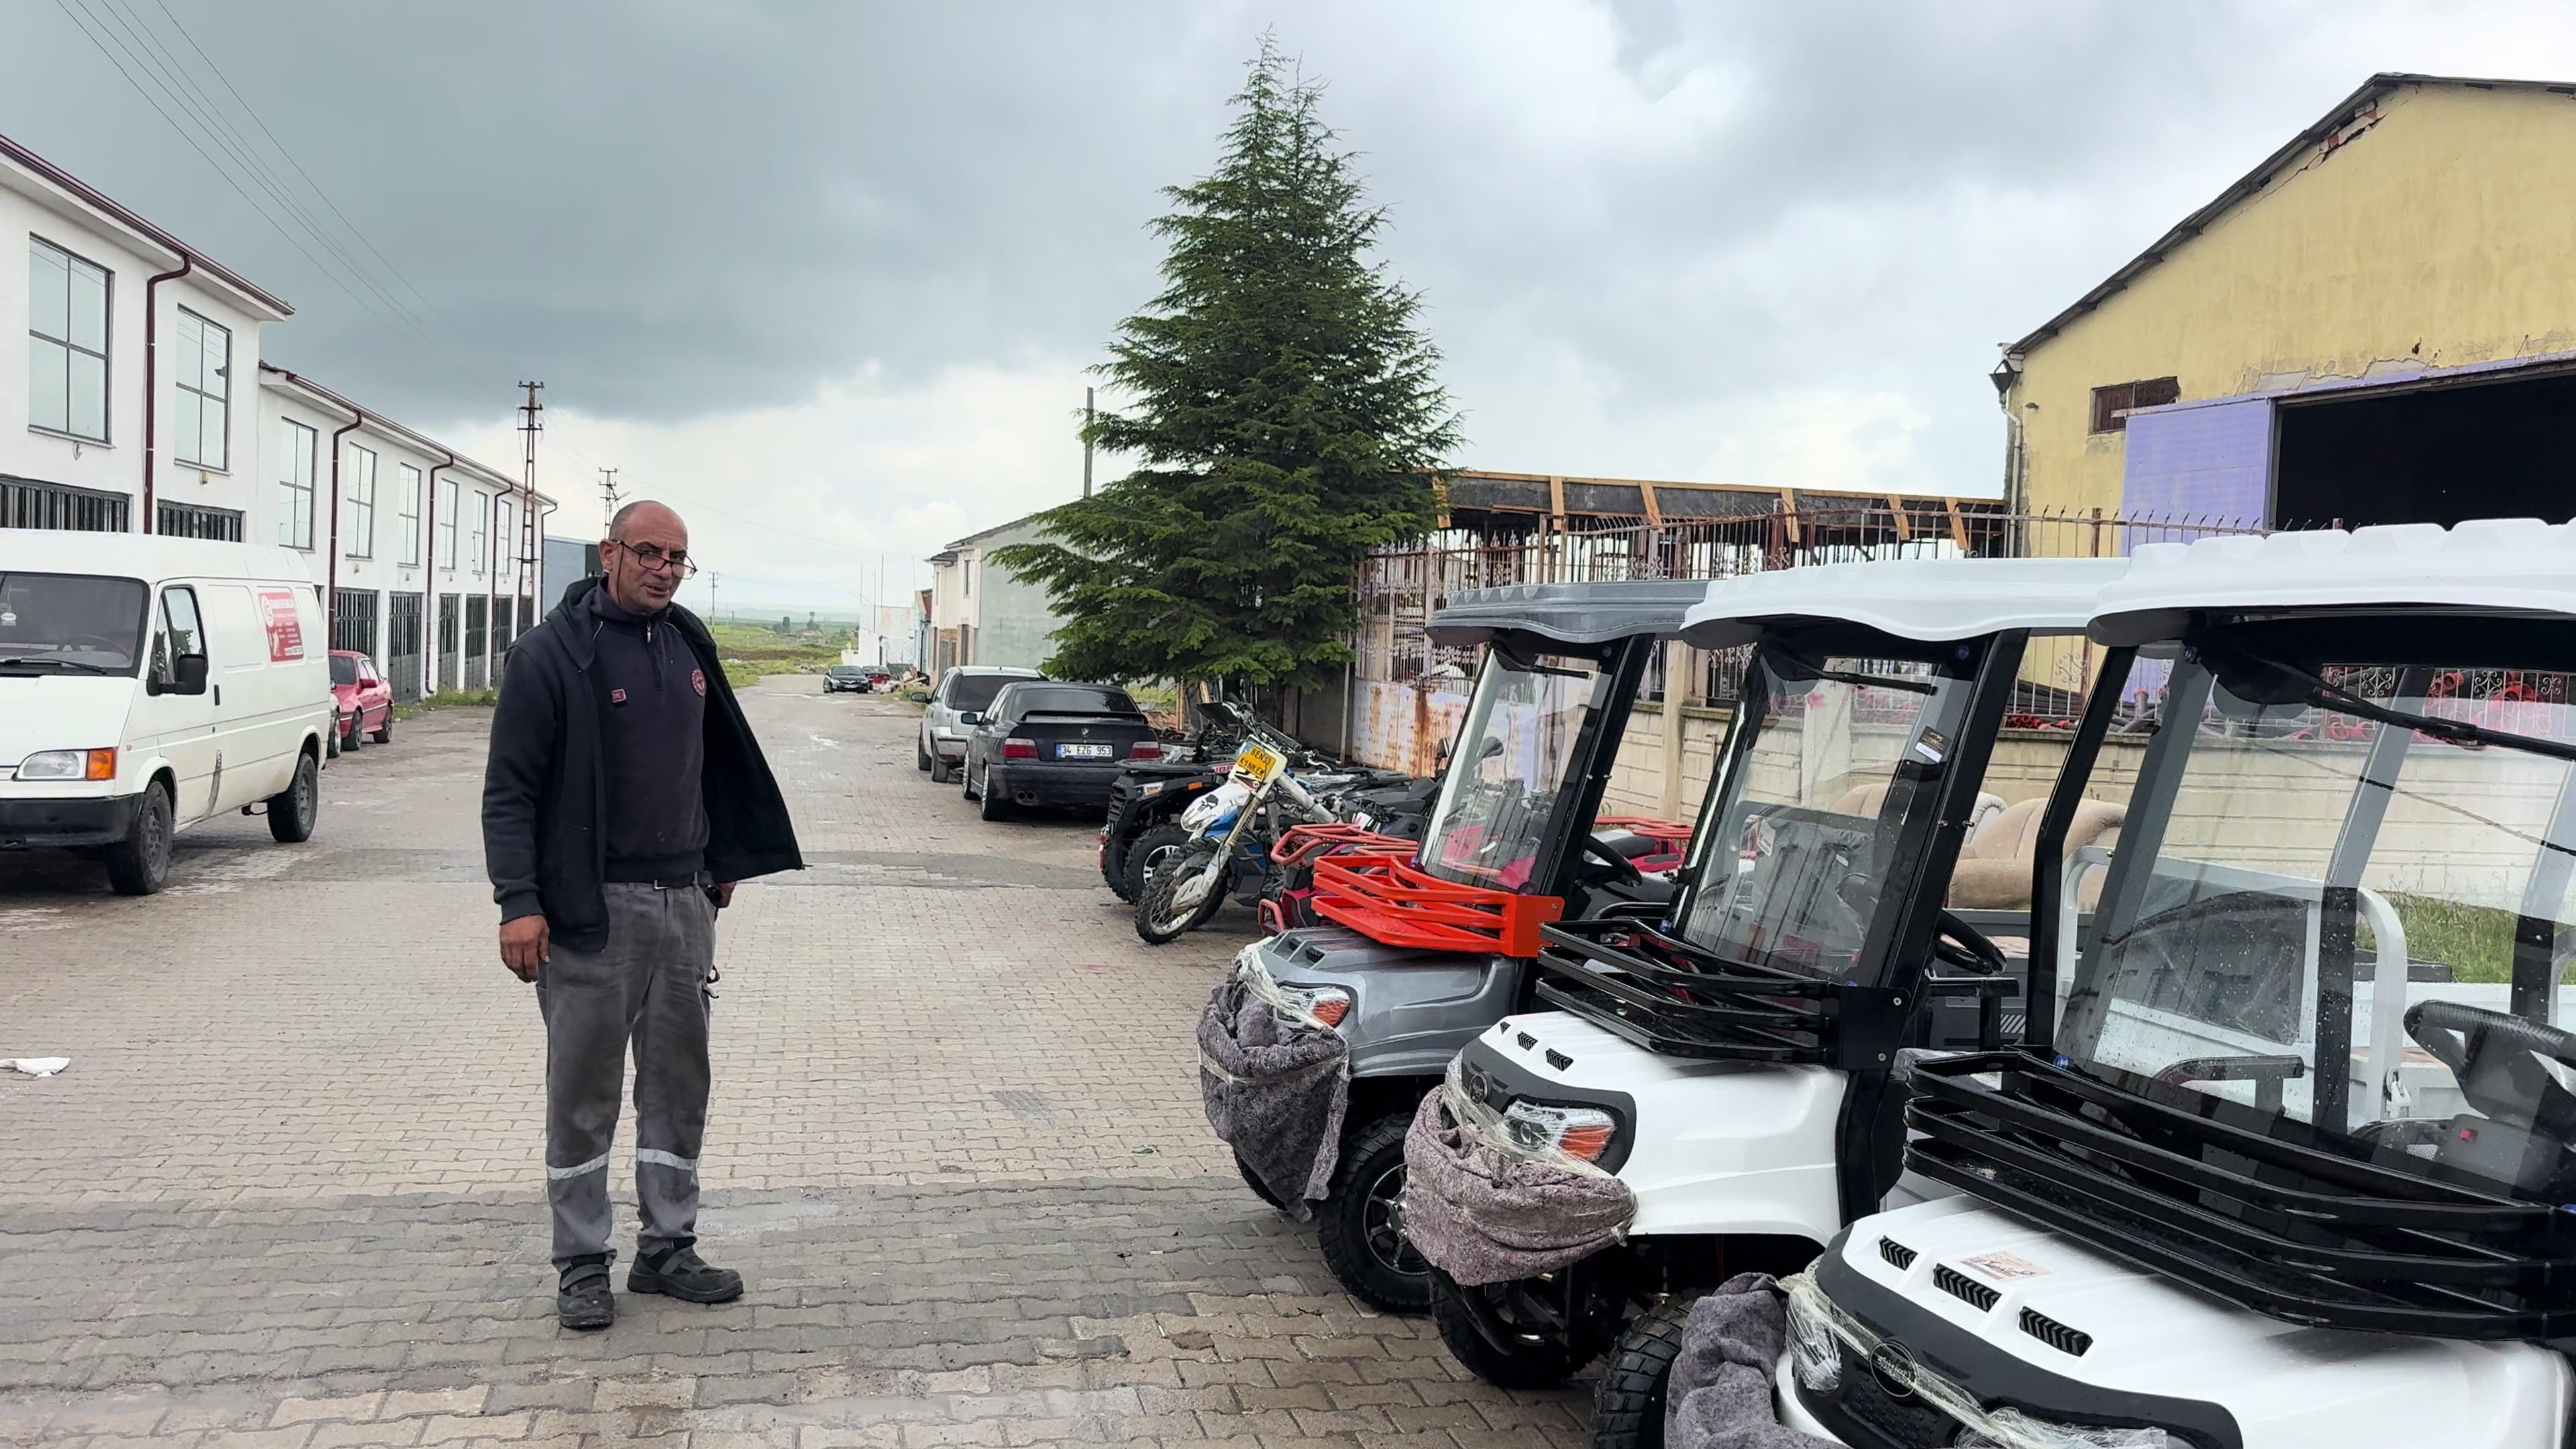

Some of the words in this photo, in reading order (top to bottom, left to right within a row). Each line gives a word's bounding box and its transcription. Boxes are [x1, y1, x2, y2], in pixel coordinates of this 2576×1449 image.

[1062, 745, 1071, 754] 34
[1077, 745, 1091, 755] EZG
[1096, 747, 1112, 755] 953
